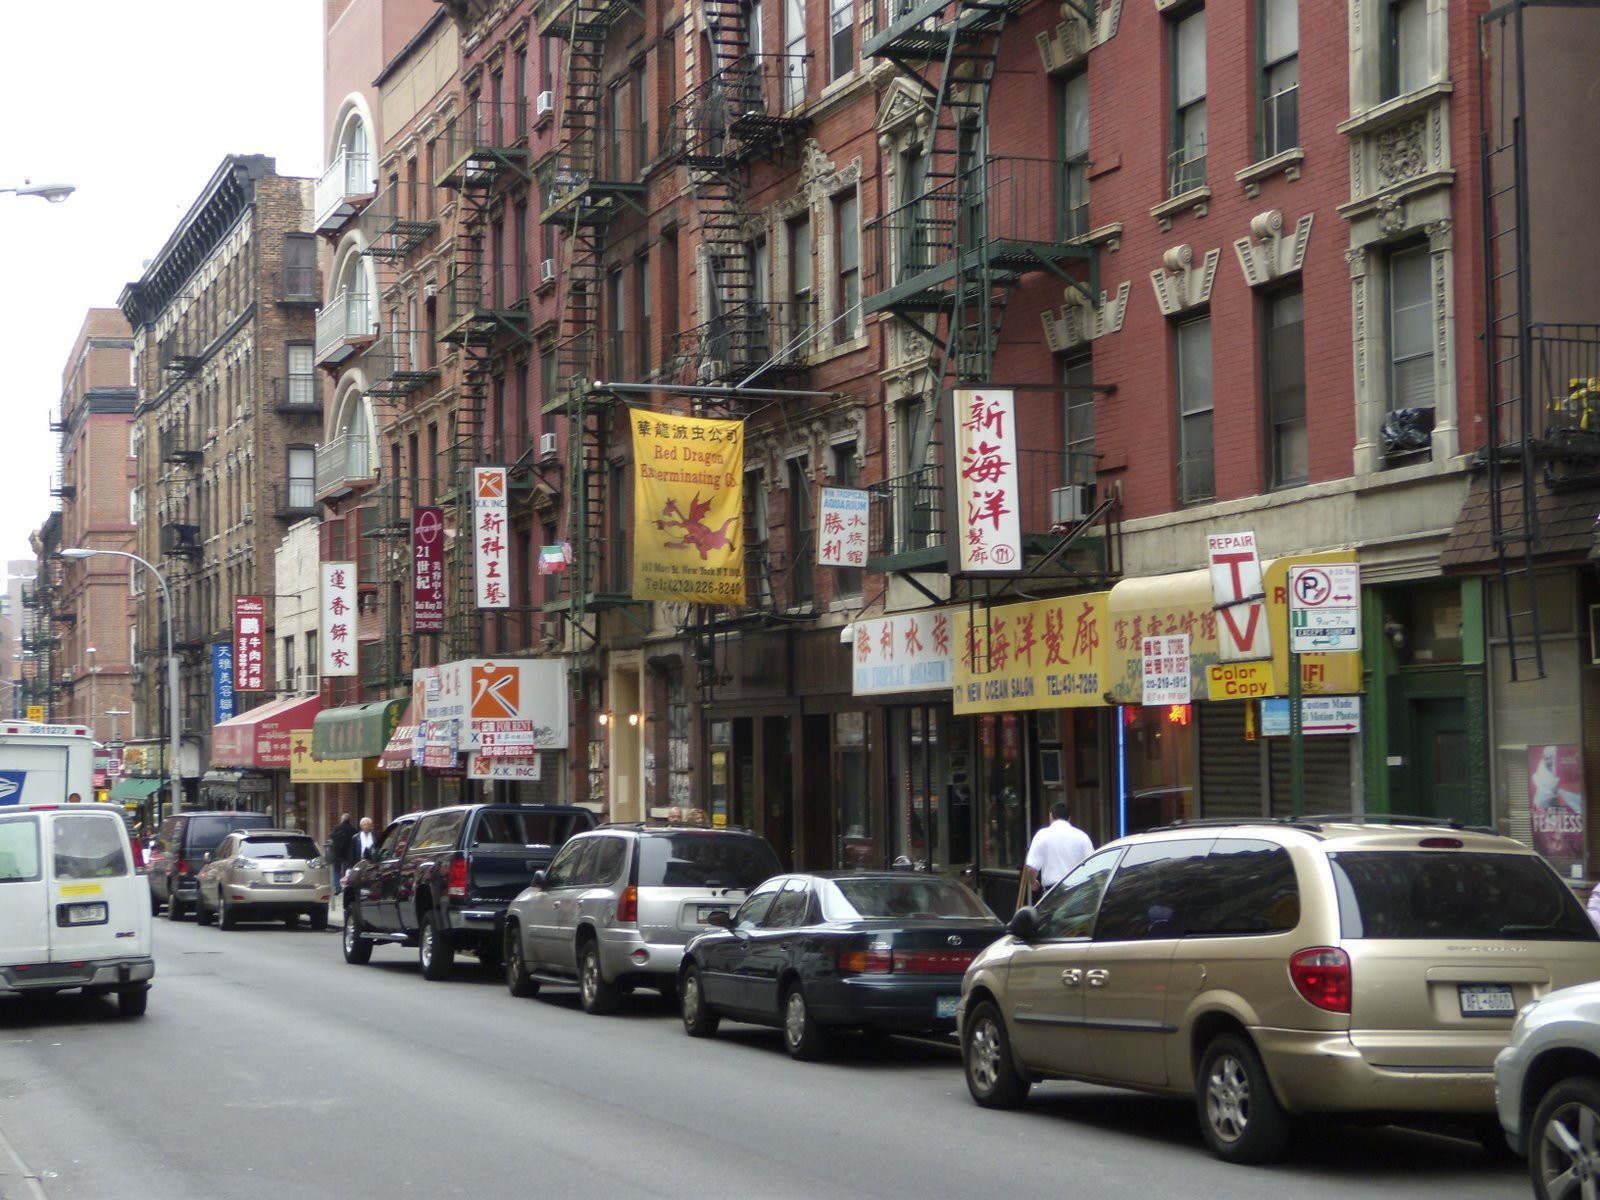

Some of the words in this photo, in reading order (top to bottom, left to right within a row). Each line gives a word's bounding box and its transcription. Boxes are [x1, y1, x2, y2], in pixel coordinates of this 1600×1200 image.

[655, 445, 677, 461] Red
[684, 447, 724, 467] Dragon
[960, 394, 1012, 531] 新海洋
[824, 500, 866, 511] AQUARIUM
[823, 513, 845, 562] 勝利
[847, 514, 866, 564] 水族館
[1210, 535, 1254, 550] REPAIR
[416, 545, 430, 558] 21
[480, 513, 506, 605] 新科工藝
[329, 569, 350, 668] 蓮香餅家
[961, 600, 1101, 676] 新海洋髮廊
[1211, 667, 1257, 682] Color
[968, 681, 981, 702] NEW
[985, 678, 1008, 700] OCEAN
[1011, 676, 1034, 697] SALON
[1225, 682, 1268, 696] Copy
[1332, 699, 1353, 709] Made
[1532, 814, 1584, 834] FEARLESS
